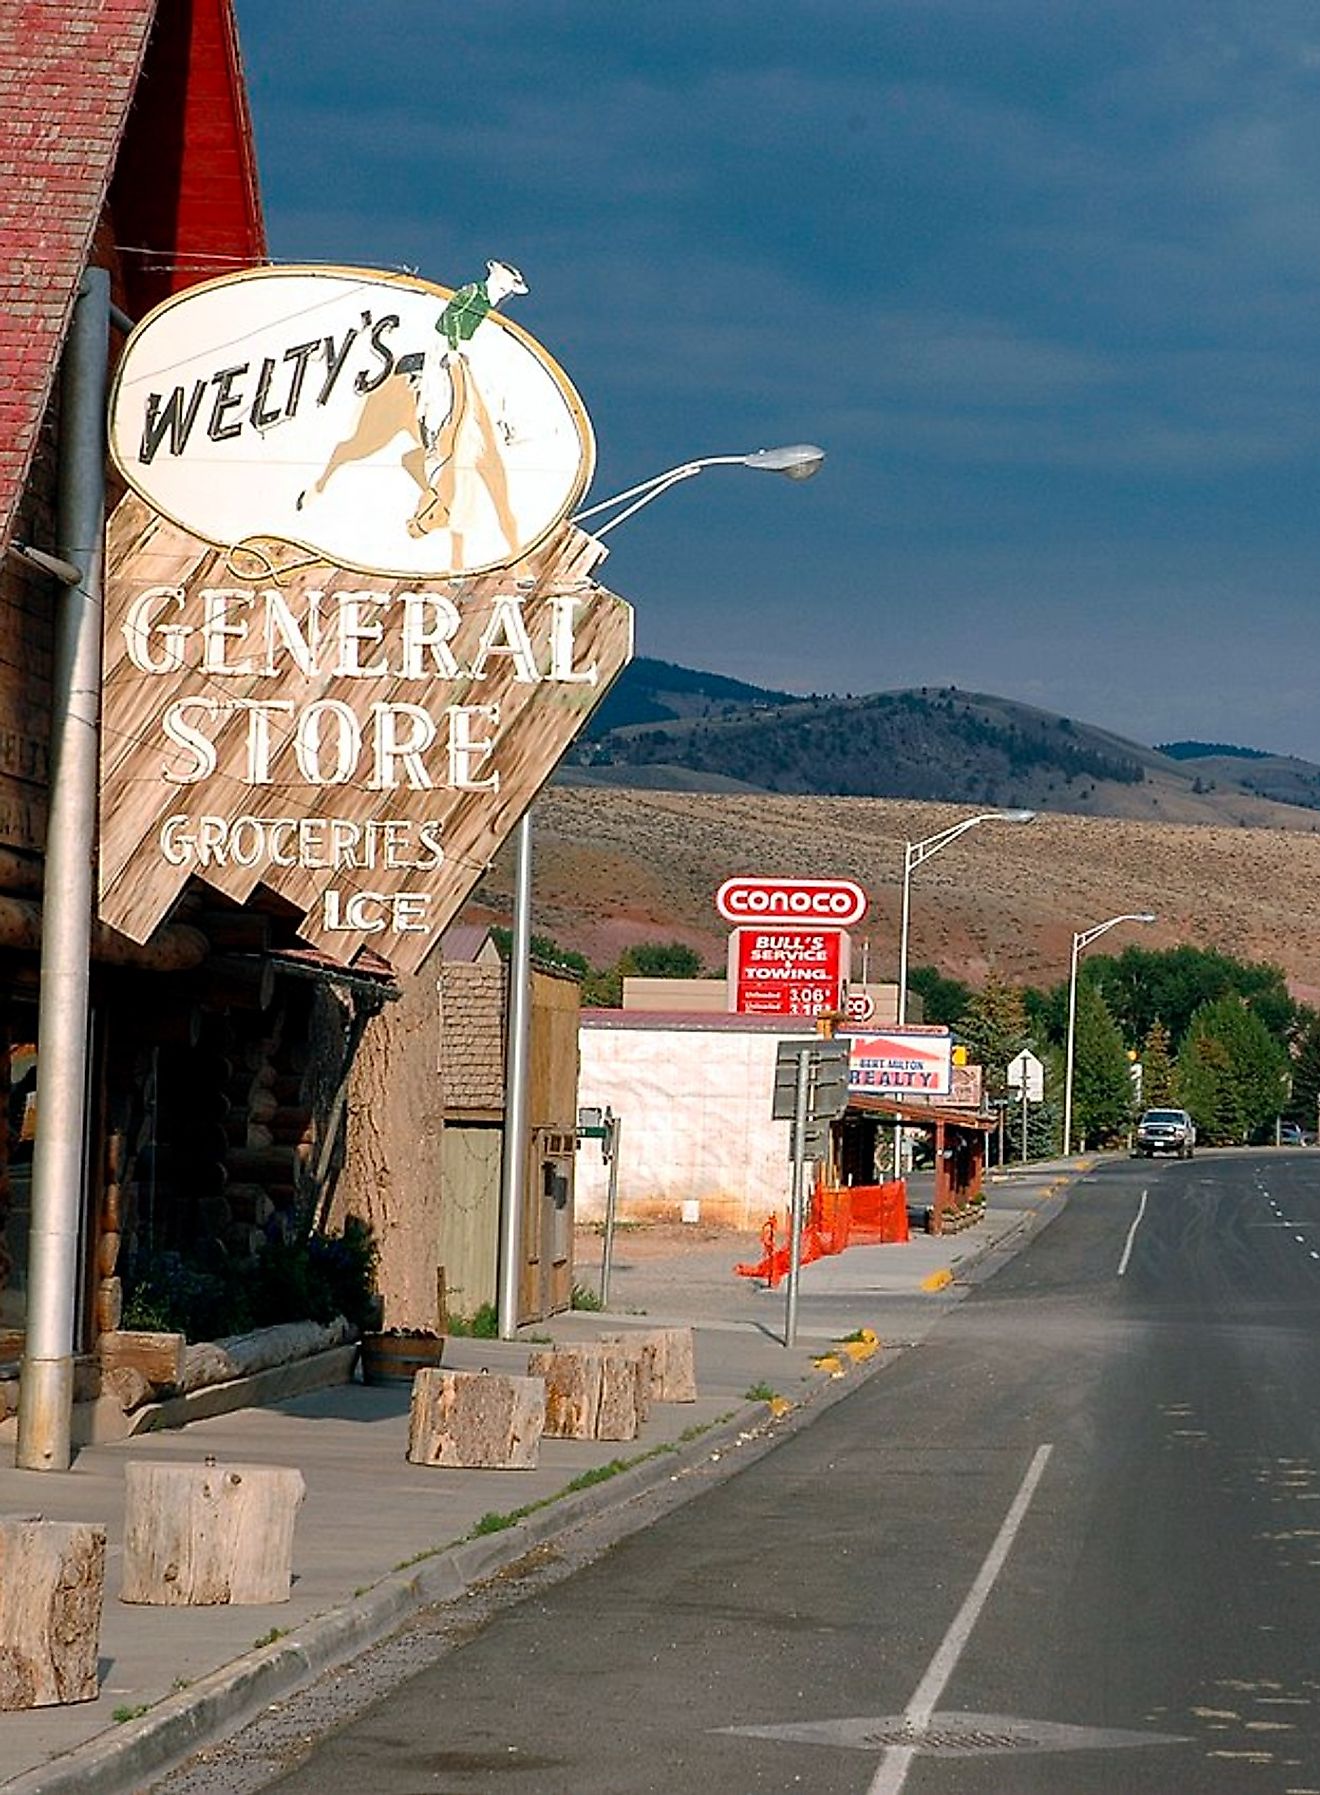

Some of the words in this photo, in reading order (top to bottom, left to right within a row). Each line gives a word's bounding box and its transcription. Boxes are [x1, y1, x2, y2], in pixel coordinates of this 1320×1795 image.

[138, 309, 400, 465] WELTY'S
[120, 584, 598, 686] GENERAL
[160, 697, 499, 793] STORE
[159, 813, 445, 872] GROCERIES
[323, 889, 432, 934] ICE
[750, 949, 828, 961] SERVICE
[755, 936, 825, 950] BULL'S
[850, 1070, 932, 1087] REALTY
